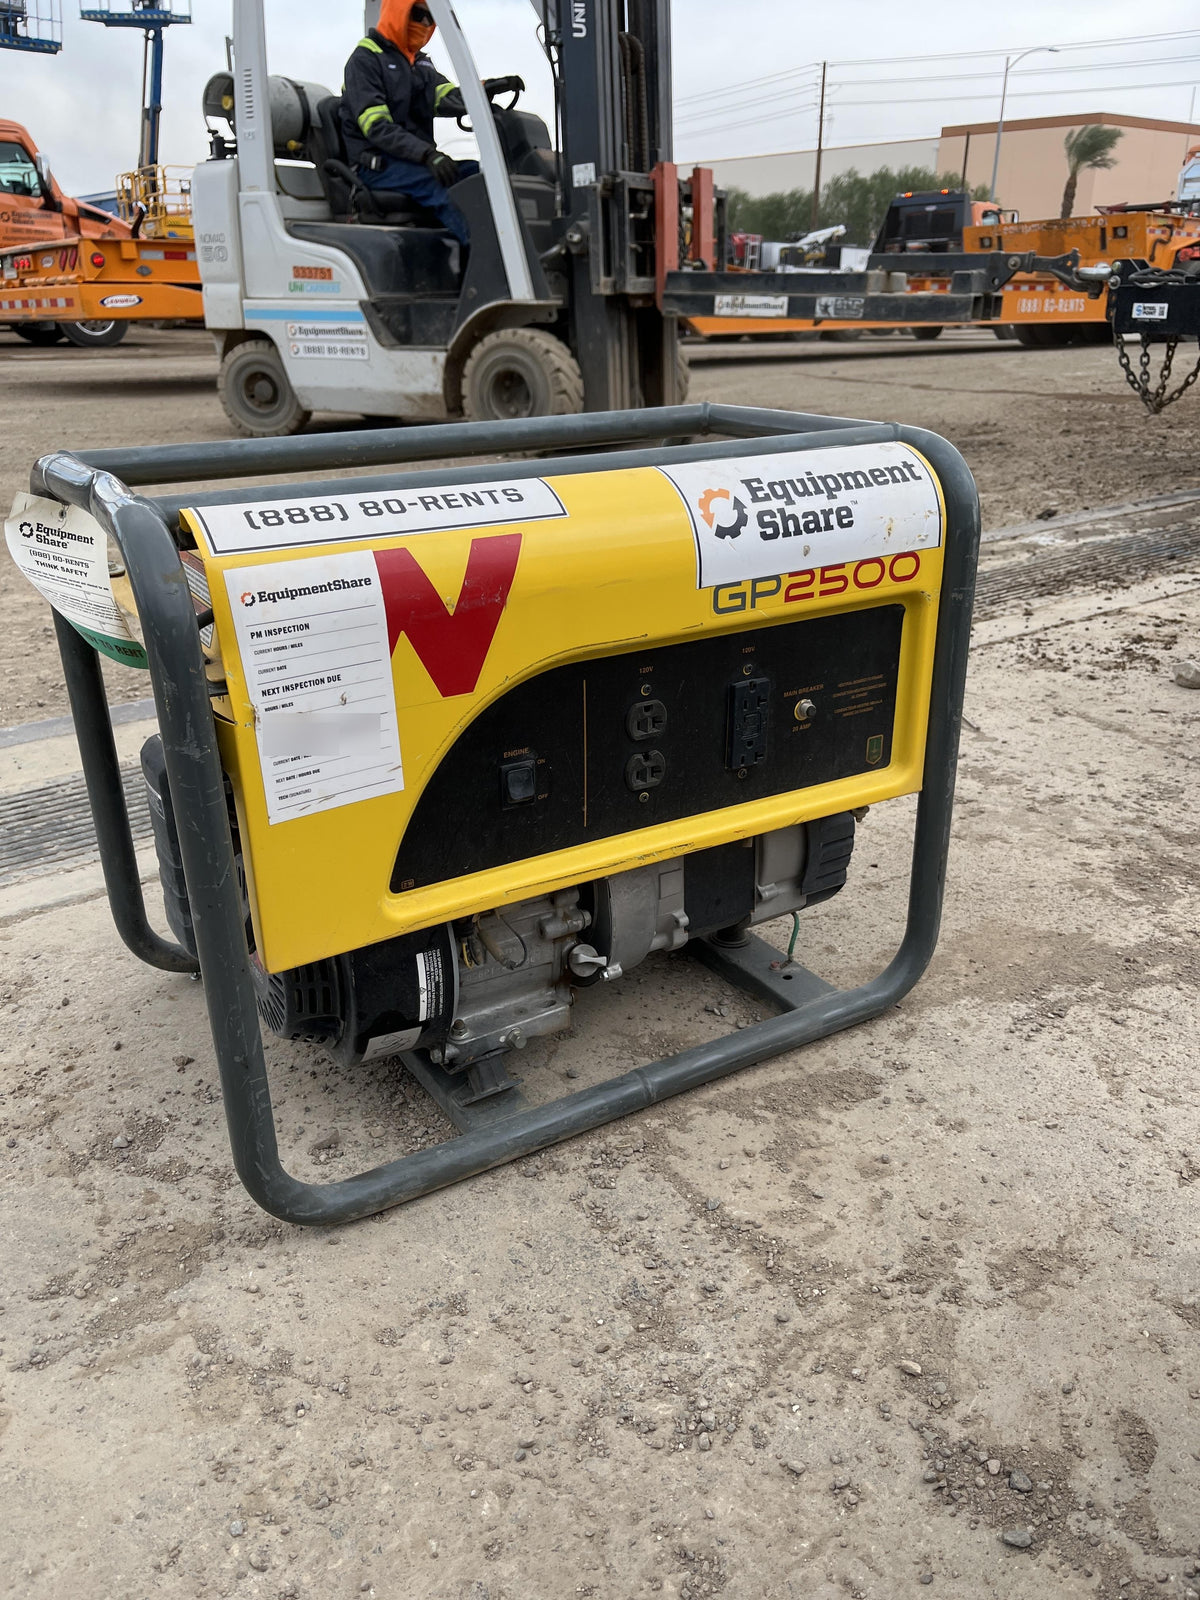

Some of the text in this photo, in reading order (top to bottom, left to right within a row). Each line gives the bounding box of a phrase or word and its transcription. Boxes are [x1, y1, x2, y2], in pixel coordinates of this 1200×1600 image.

[740, 460, 922, 506] Equipment
[243, 487, 525, 530] (888) 80-RENTS
[36, 522, 94, 546] Equipment
[29, 549, 90, 569] (888) 80-RENTS
[35, 560, 59, 572] THINK
[60, 566, 88, 578] SAFETY
[256, 576, 372, 603] EquipmentShare
[713, 551, 920, 615] GP2500
[250, 623, 310, 640] PM INSPECTION
[114, 644, 144, 658] RENT
[254, 647, 273, 656] CURRENT
[742, 646, 756, 654] 120V
[258, 664, 288, 675] CURRENT DATE
[640, 666, 654, 674] 120V
[262, 674, 342, 698] NEXT INSPECTION DUE
[784, 688, 798, 698] MAIN
[798, 684, 824, 694] BREAKER
[264, 704, 279, 713] HOURS
[503, 746, 530, 758] ENGINE
[286, 774, 296, 782] DATE
[538, 792, 549, 800] OFF
